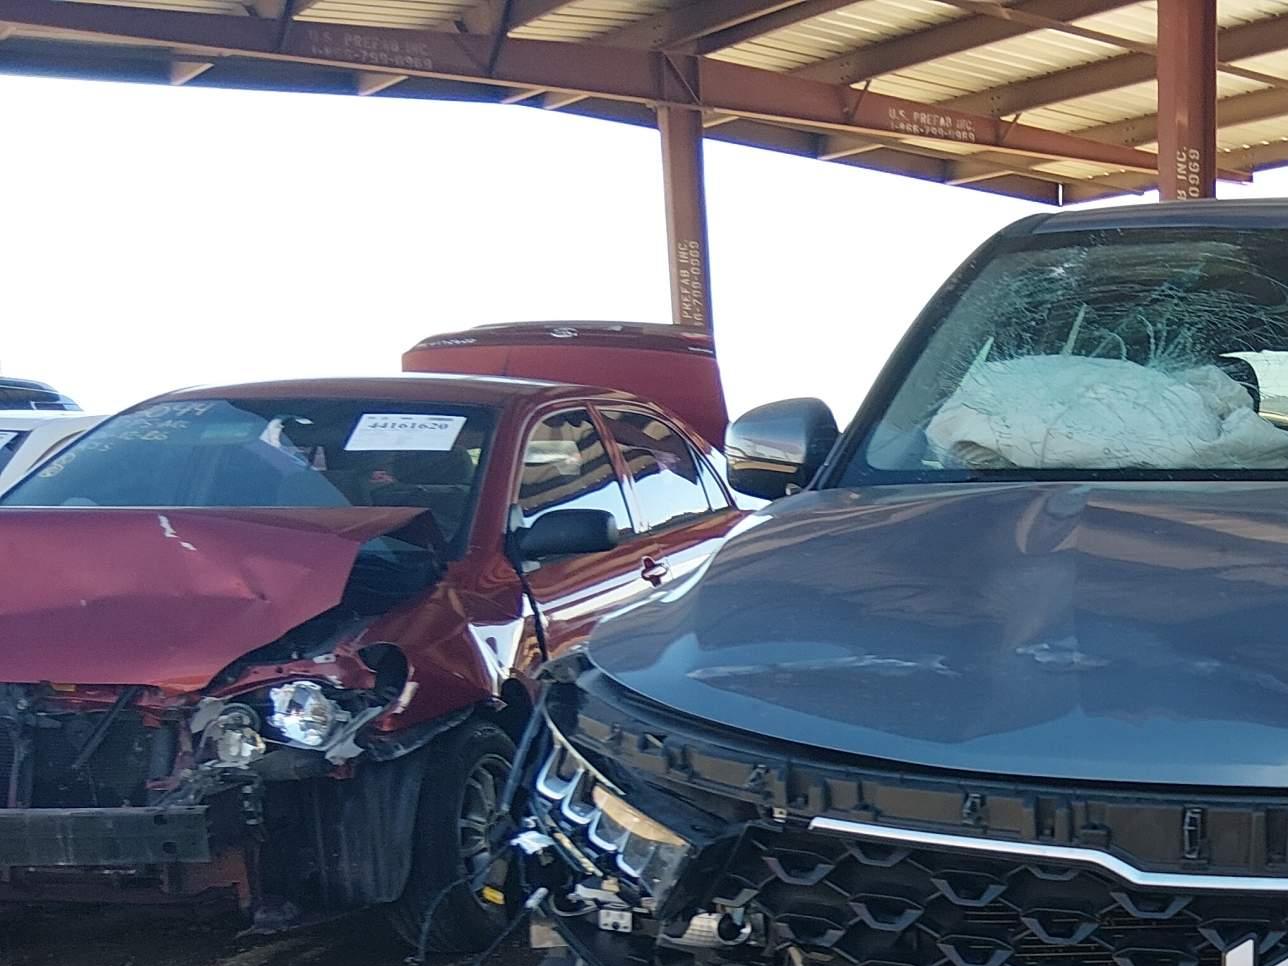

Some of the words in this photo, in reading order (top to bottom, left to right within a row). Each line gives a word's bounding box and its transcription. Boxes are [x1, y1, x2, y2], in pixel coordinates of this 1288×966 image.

[913, 111, 952, 128] PREFAB
[1176, 146, 1187, 180] INC.
[680, 269, 692, 319] PREFAB
[368, 422, 449, 430] 44161620
